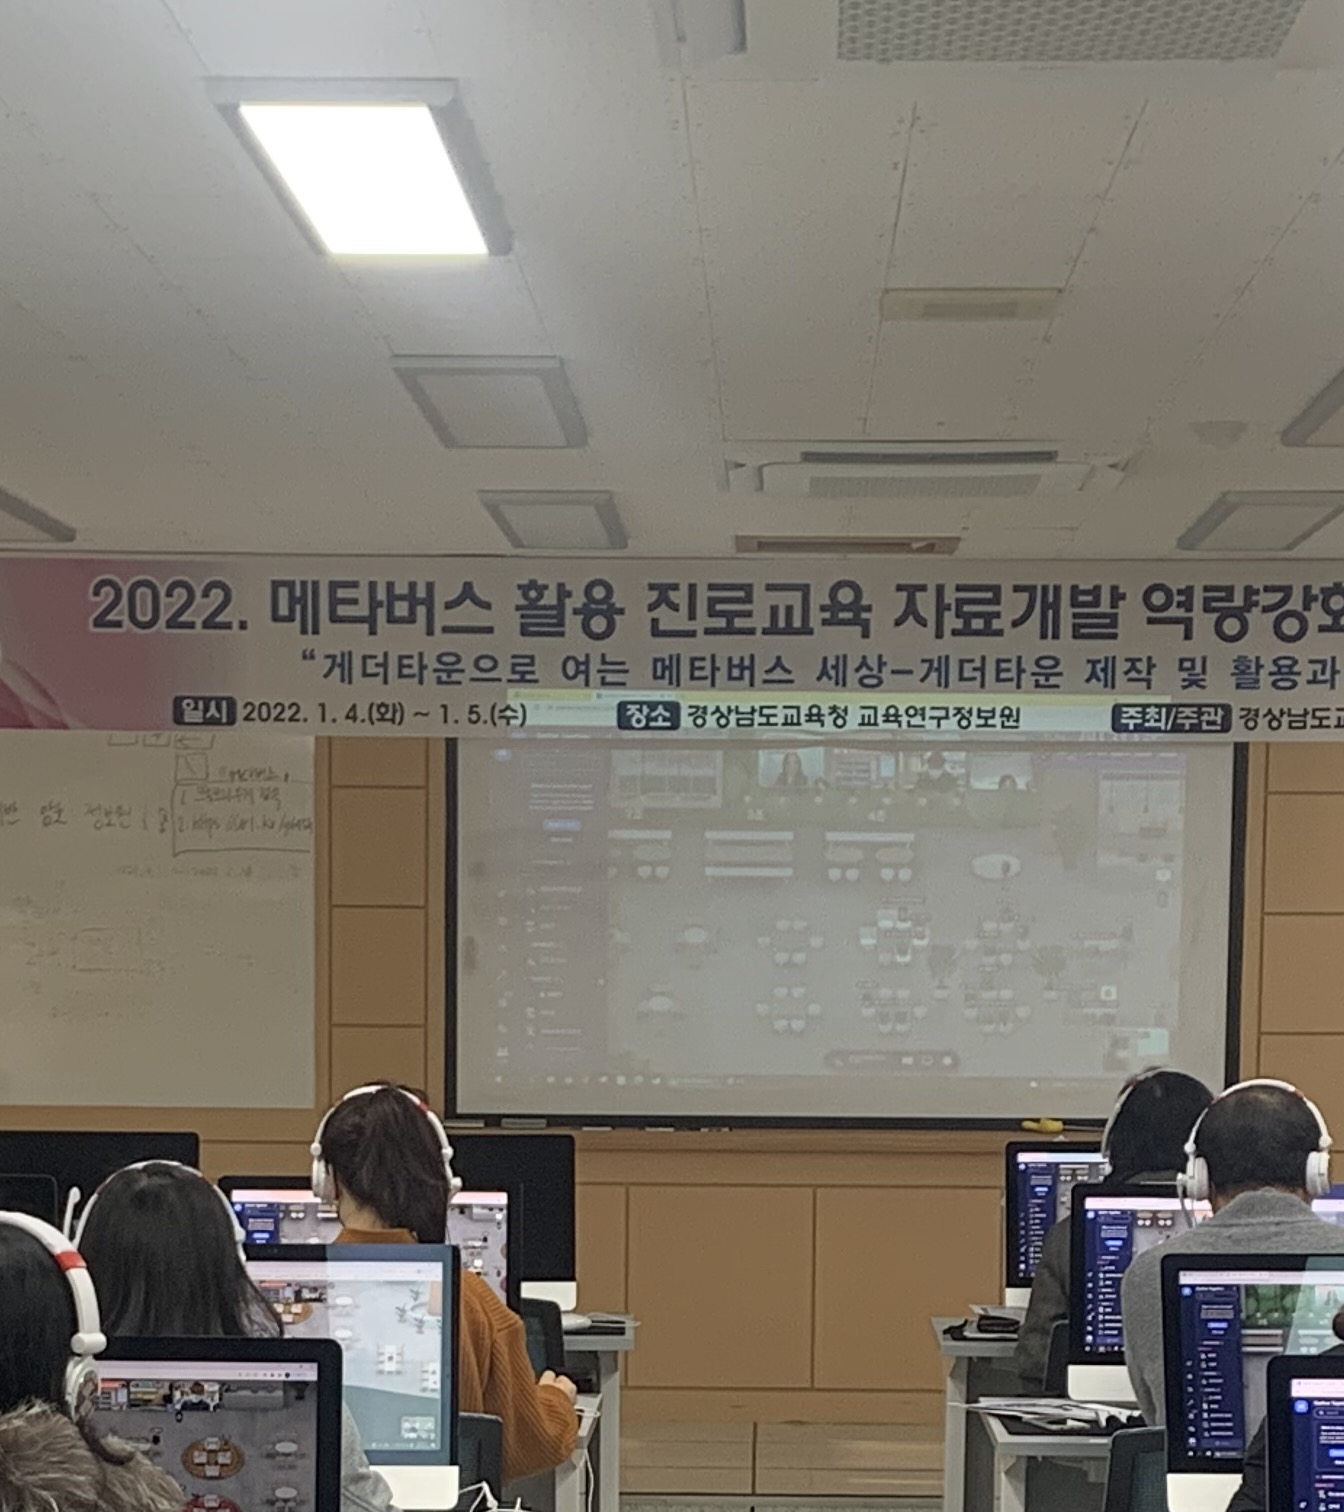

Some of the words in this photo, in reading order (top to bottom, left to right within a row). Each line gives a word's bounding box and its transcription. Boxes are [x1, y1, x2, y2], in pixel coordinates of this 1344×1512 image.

[89, 578, 248, 631] 2022.
[270, 579, 495, 636] 메타버스
[514, 579, 625, 640] 활용
[646, 579, 873, 639] 진로교육
[894, 582, 1126, 640] 자료개발
[560, 652, 630, 687] 여는
[651, 653, 796, 688] 메타버스
[1084, 654, 1157, 690] 제작
[1177, 654, 1209, 690] 및
[180, 699, 230, 724] 일시
[242, 702, 309, 724] 2022.
[625, 705, 673, 729] 장소
[687, 704, 849, 730] 경상남도교육청
[857, 704, 1021, 730] 교육연구정보원
[1119, 705, 1225, 733] 주최/주관
